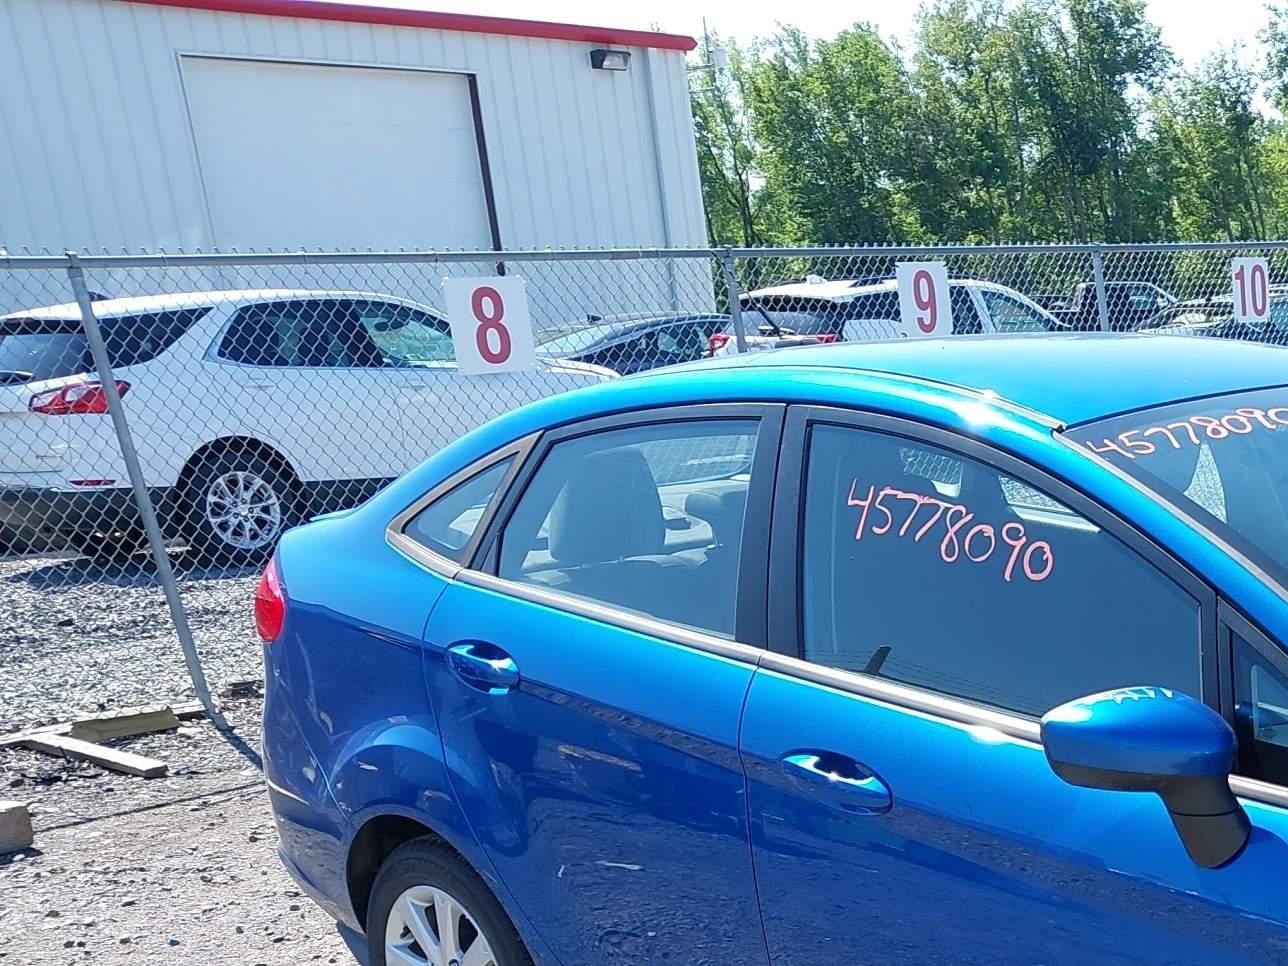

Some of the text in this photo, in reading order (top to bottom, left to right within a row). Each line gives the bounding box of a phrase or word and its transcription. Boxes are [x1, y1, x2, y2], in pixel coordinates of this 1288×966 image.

[471, 286, 511, 365] 8
[913, 269, 937, 334] 9
[1235, 264, 1266, 317] 10
[847, 478, 1054, 582] 45778090
